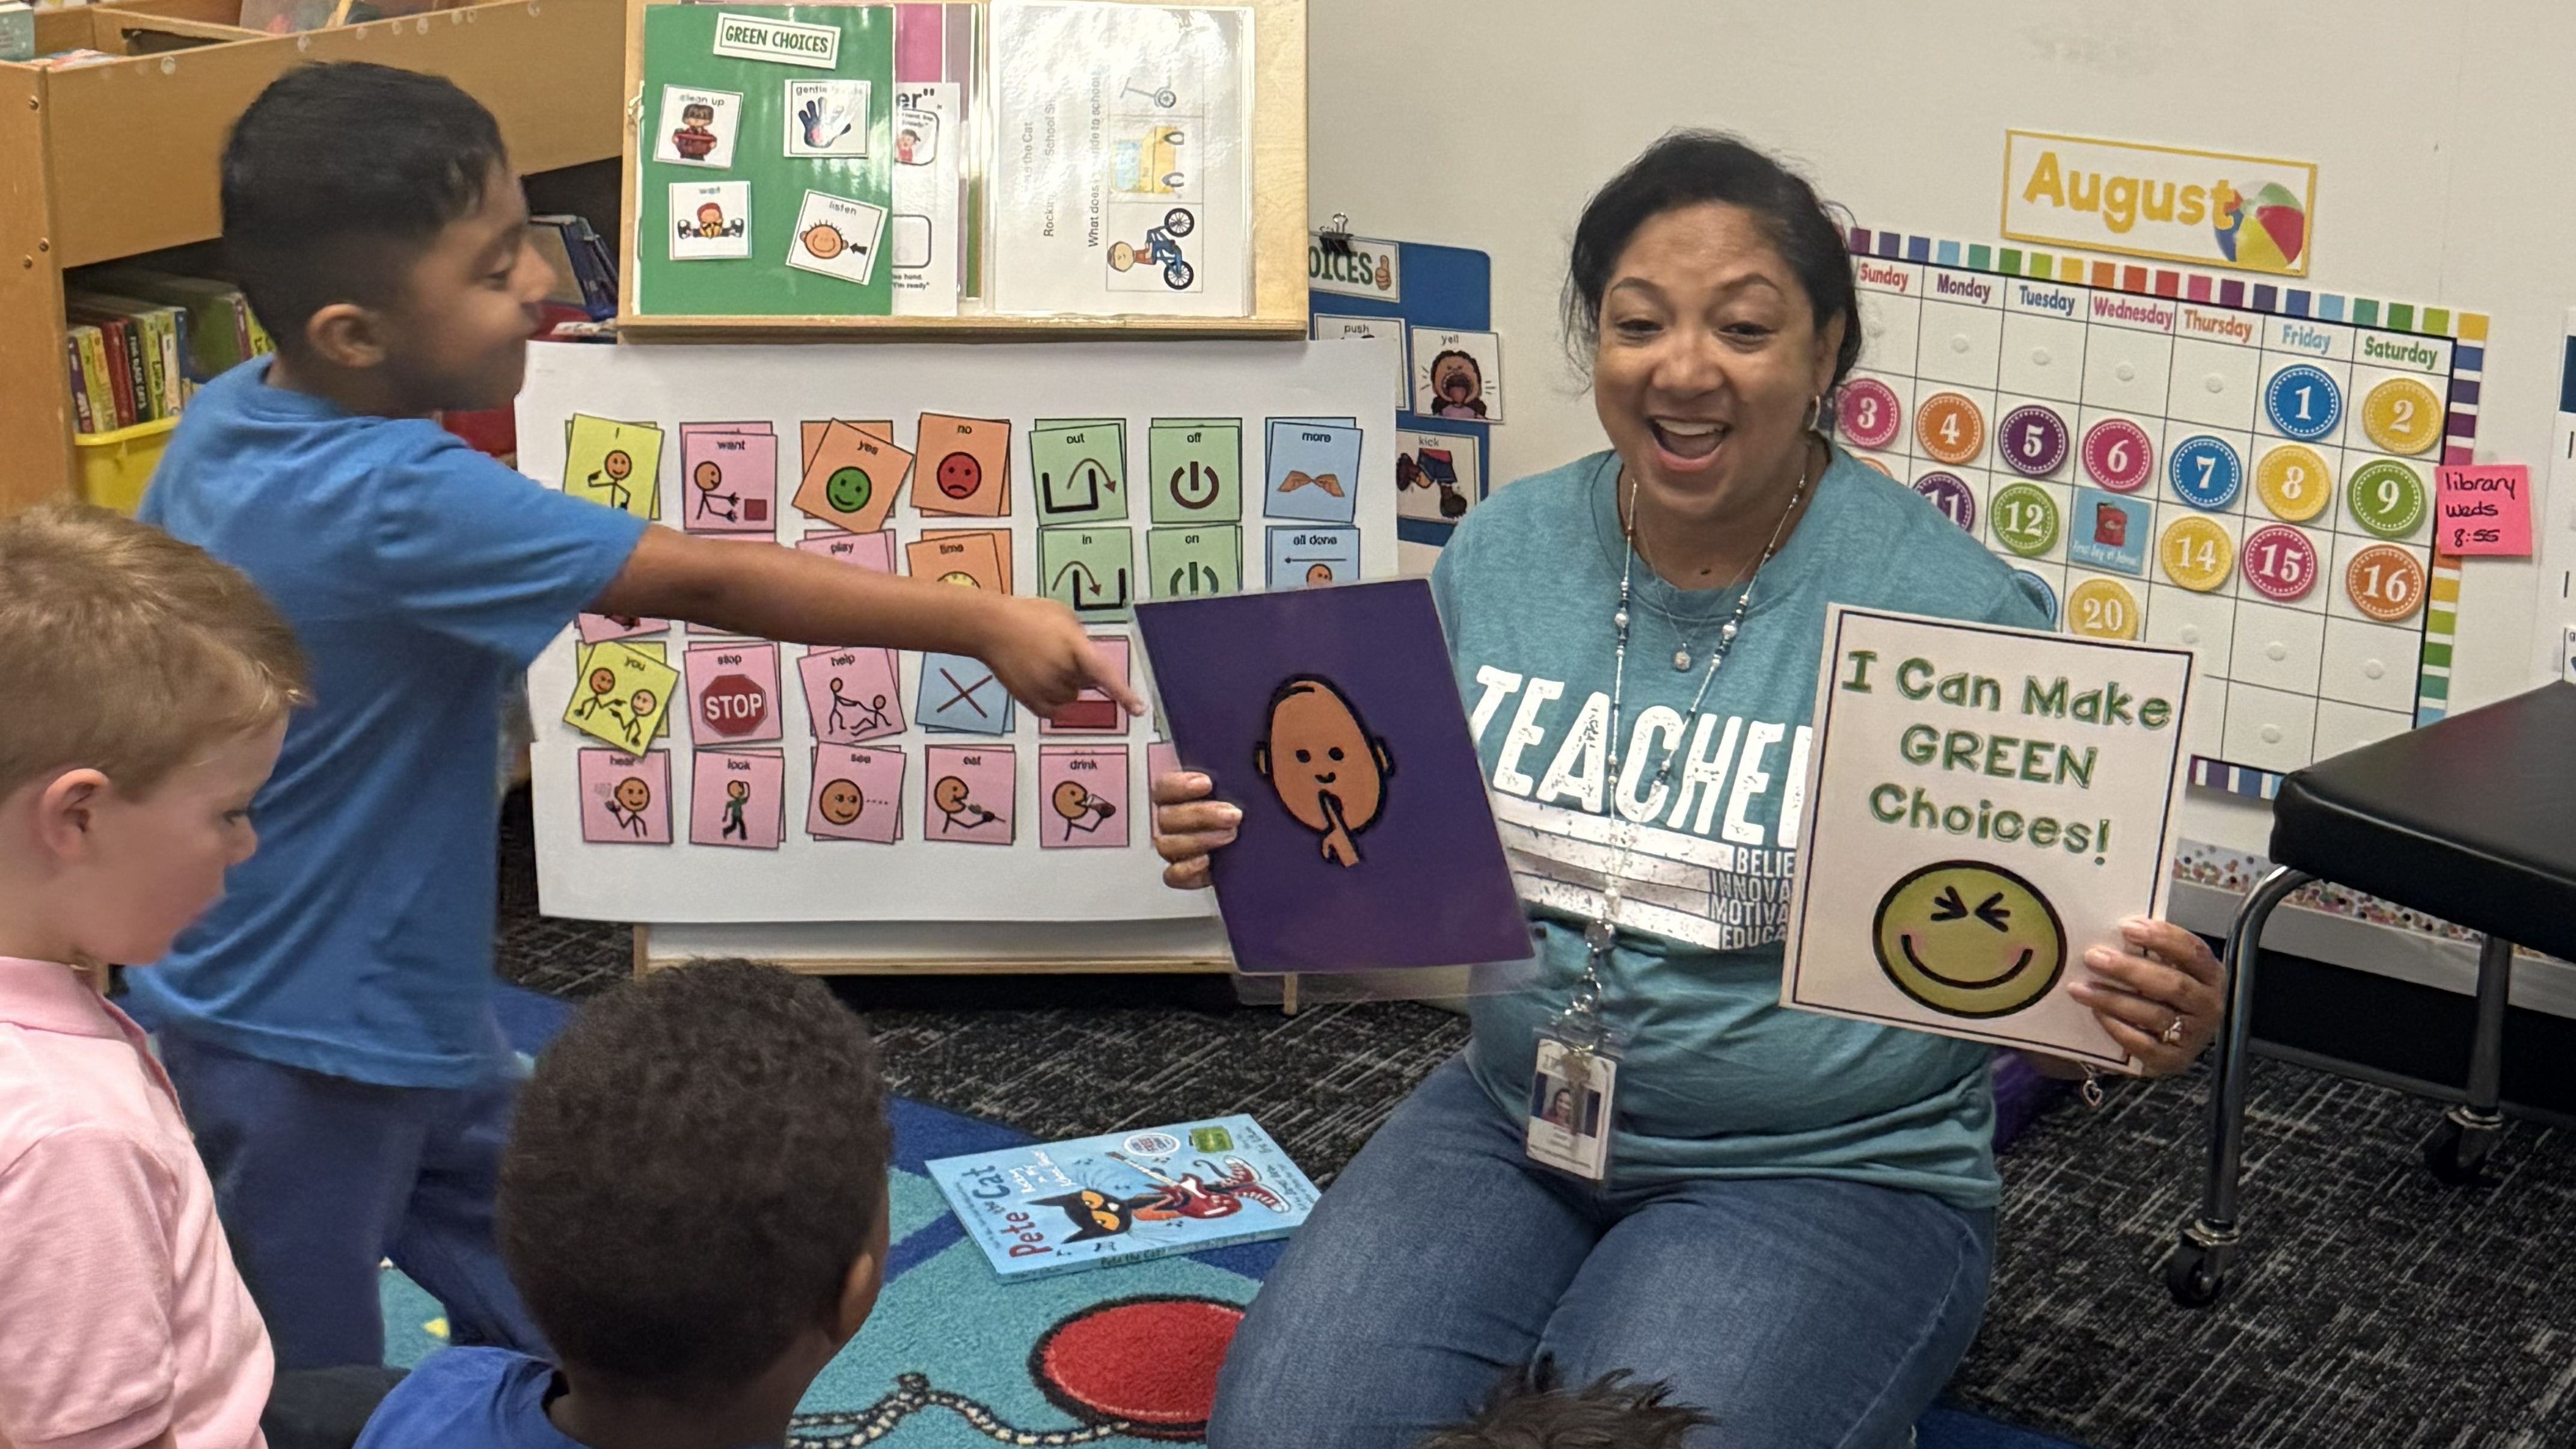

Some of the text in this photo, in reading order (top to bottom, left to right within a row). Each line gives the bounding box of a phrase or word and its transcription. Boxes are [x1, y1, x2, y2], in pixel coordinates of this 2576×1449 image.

[725, 25, 829, 54] GREEN CHOICES
[796, 85, 827, 96] gentle
[711, 99, 725, 107] up
[1022, 122, 1033, 143] Cat
[1089, 185, 1100, 214] does
[2023, 152, 2235, 234] August
[829, 201, 857, 215] listen
[1088, 217, 1099, 247] What
[1859, 263, 2438, 370] Sunday Monday Tuesday Wednesday Thursday Friday Saturday
[1344, 323, 1370, 336] push
[1441, 334, 1459, 347] yell
[1857, 397, 1878, 429] 3
[2295, 386, 2312, 420] 1
[2389, 399, 2414, 433] 2
[615, 427, 619, 439] I
[957, 424, 972, 435] no
[1186, 432, 1202, 444] off
[1301, 432, 1332, 444] more
[1939, 413, 1960, 445] 4
[717, 440, 746, 451] want
[857, 440, 879, 456] yes
[1066, 434, 1085, 445] out
[1418, 435, 1440, 447] kick
[2022, 424, 2044, 457] 5
[2108, 440, 2129, 473] 6
[2195, 455, 2216, 489] 7
[2281, 466, 2304, 499] 8
[2445, 472, 2516, 500] library
[2377, 480, 2400, 514] 9
[2005, 501, 2044, 537] 12
[830, 541, 854, 555] play
[1083, 534, 1092, 544] in
[1185, 534, 1200, 544] on
[1293, 535, 1338, 546] all done
[2454, 529, 2501, 548] 8:55
[939, 543, 964, 555] time
[2175, 537, 2216, 572] 14
[2260, 544, 2304, 582] 15
[2363, 564, 2407, 603] 16
[2084, 598, 2123, 631] 20
[624, 655, 646, 672] you
[717, 653, 741, 666] stop
[830, 654, 856, 666] help
[1841, 650, 2173, 730] I Can Make
[705, 694, 762, 721] STOP
[727, 760, 751, 771] look
[850, 754, 872, 764] see
[963, 756, 981, 766] eat
[1070, 759, 1098, 771] drink
[1900, 723, 2098, 789] GREEN
[1868, 783, 2111, 866] Choices!
[961, 1165, 1011, 1199] Cat
[984, 1201, 1006, 1215] the
[1000, 1211, 1053, 1258] Pete
